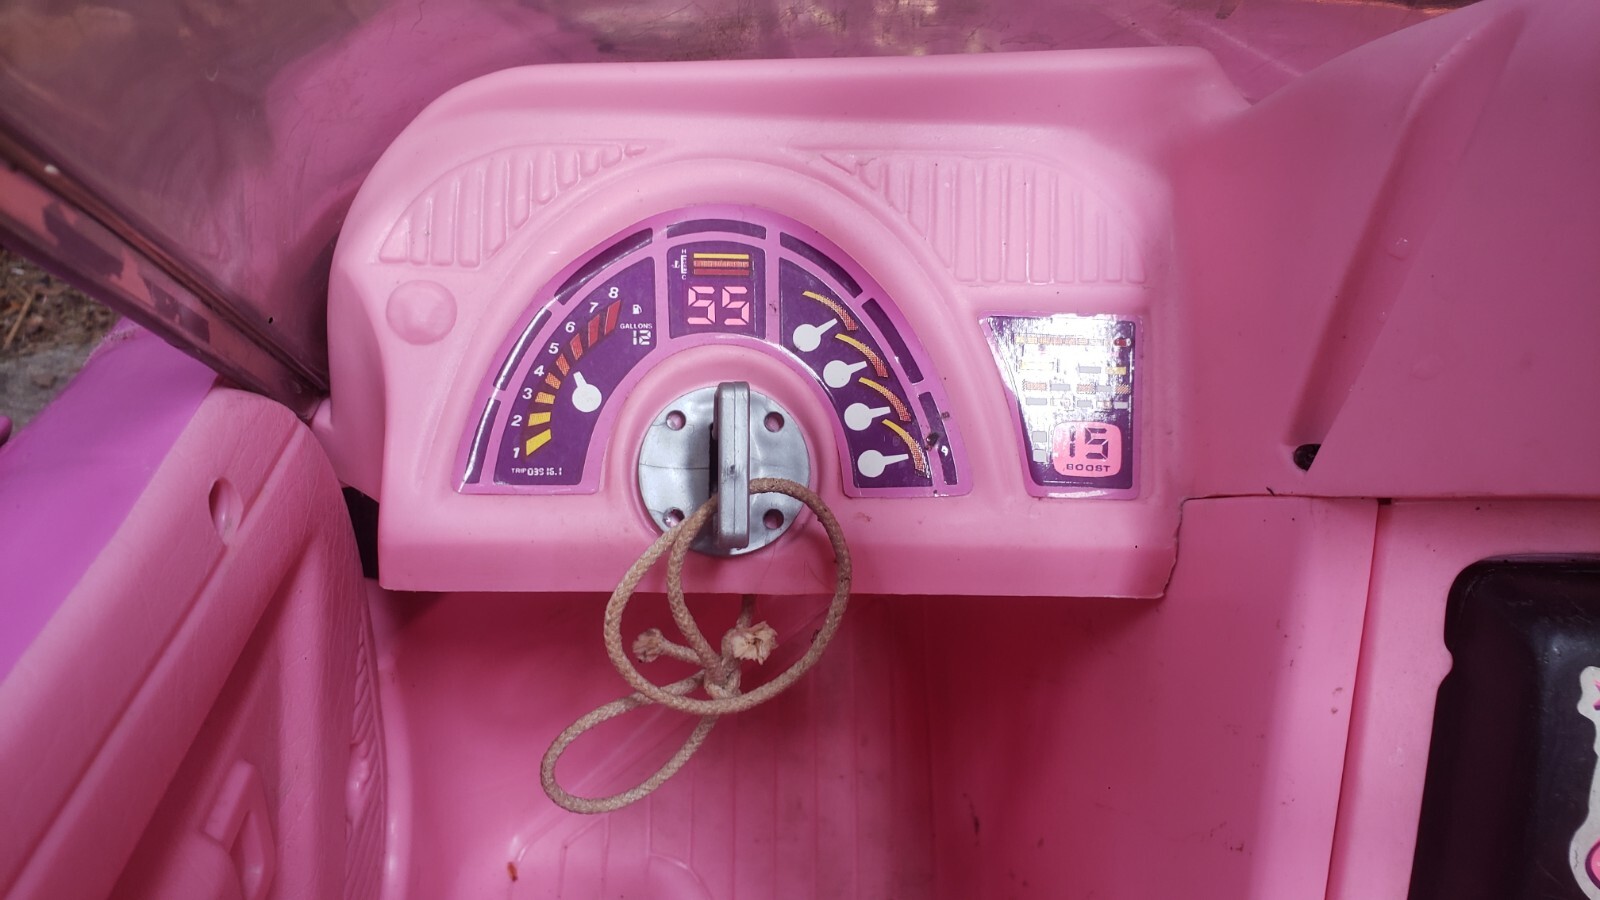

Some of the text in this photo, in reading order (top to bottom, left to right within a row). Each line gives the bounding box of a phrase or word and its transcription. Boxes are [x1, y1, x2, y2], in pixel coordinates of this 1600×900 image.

[608, 286, 619, 299] 8
[589, 302, 599, 314] 7
[687, 286, 749, 326] 55
[565, 321, 576, 333] 6
[619, 322, 653, 330] GALLONS
[632, 329, 652, 346] 12
[548, 342, 559, 354] 5
[533, 365, 545, 377] 4
[522, 388, 532, 400] 3
[511, 415, 522, 427] 2
[1069, 426, 1109, 460] 15
[513, 447, 520, 459] 1
[1066, 463, 1111, 473] BOOST
